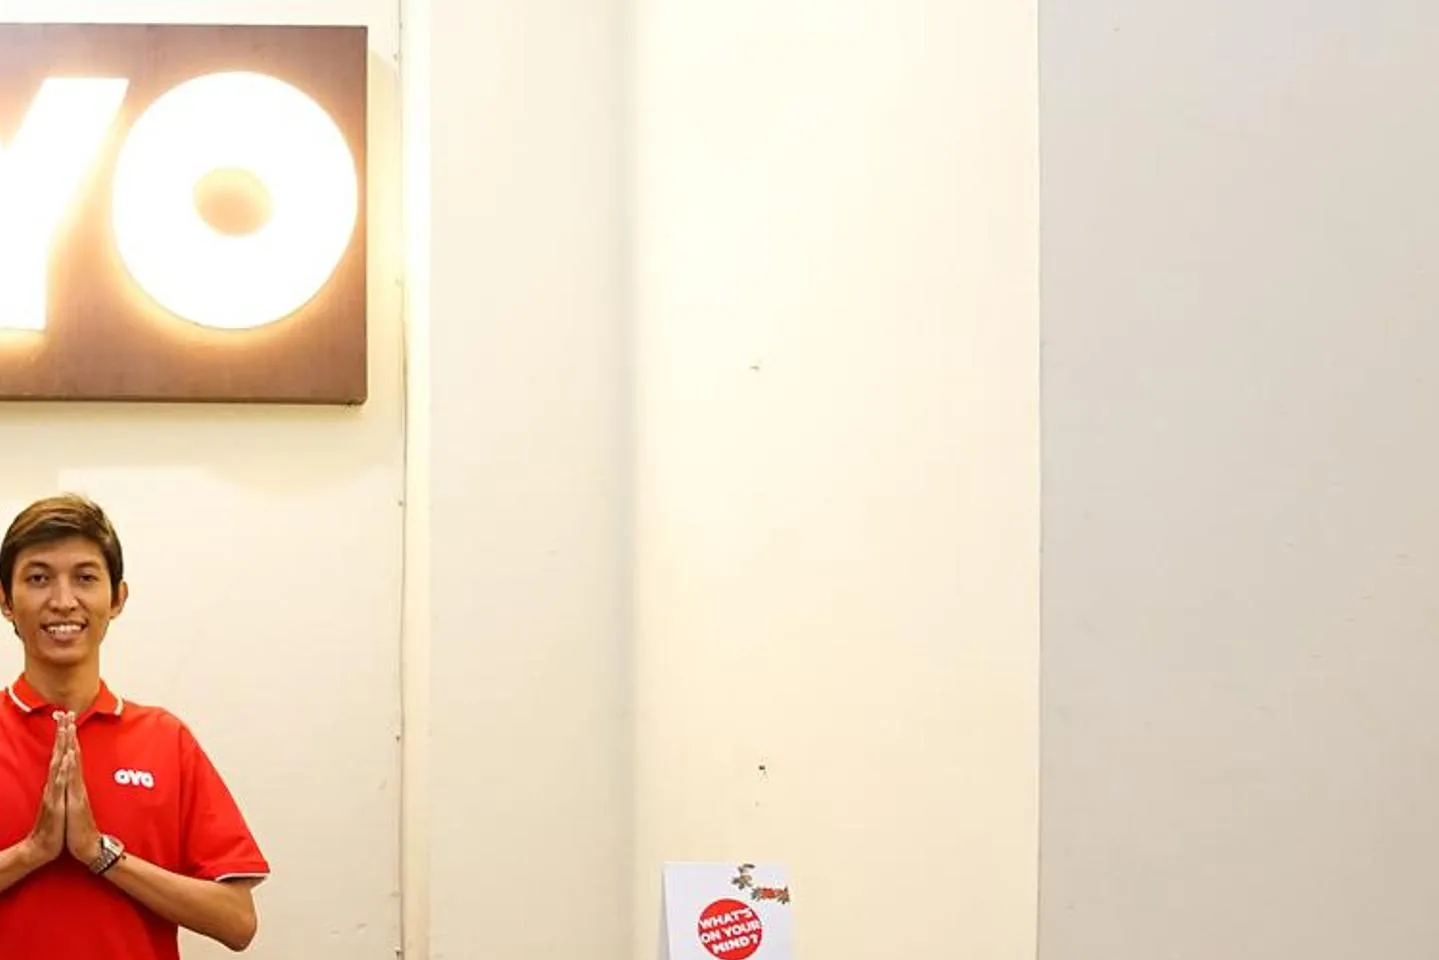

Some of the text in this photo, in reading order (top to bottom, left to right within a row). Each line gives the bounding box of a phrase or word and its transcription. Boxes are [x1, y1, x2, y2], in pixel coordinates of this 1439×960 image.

[114, 769, 154, 788] OYO
[699, 908, 754, 930] WHAT'S
[702, 920, 762, 944] ON YOUR
